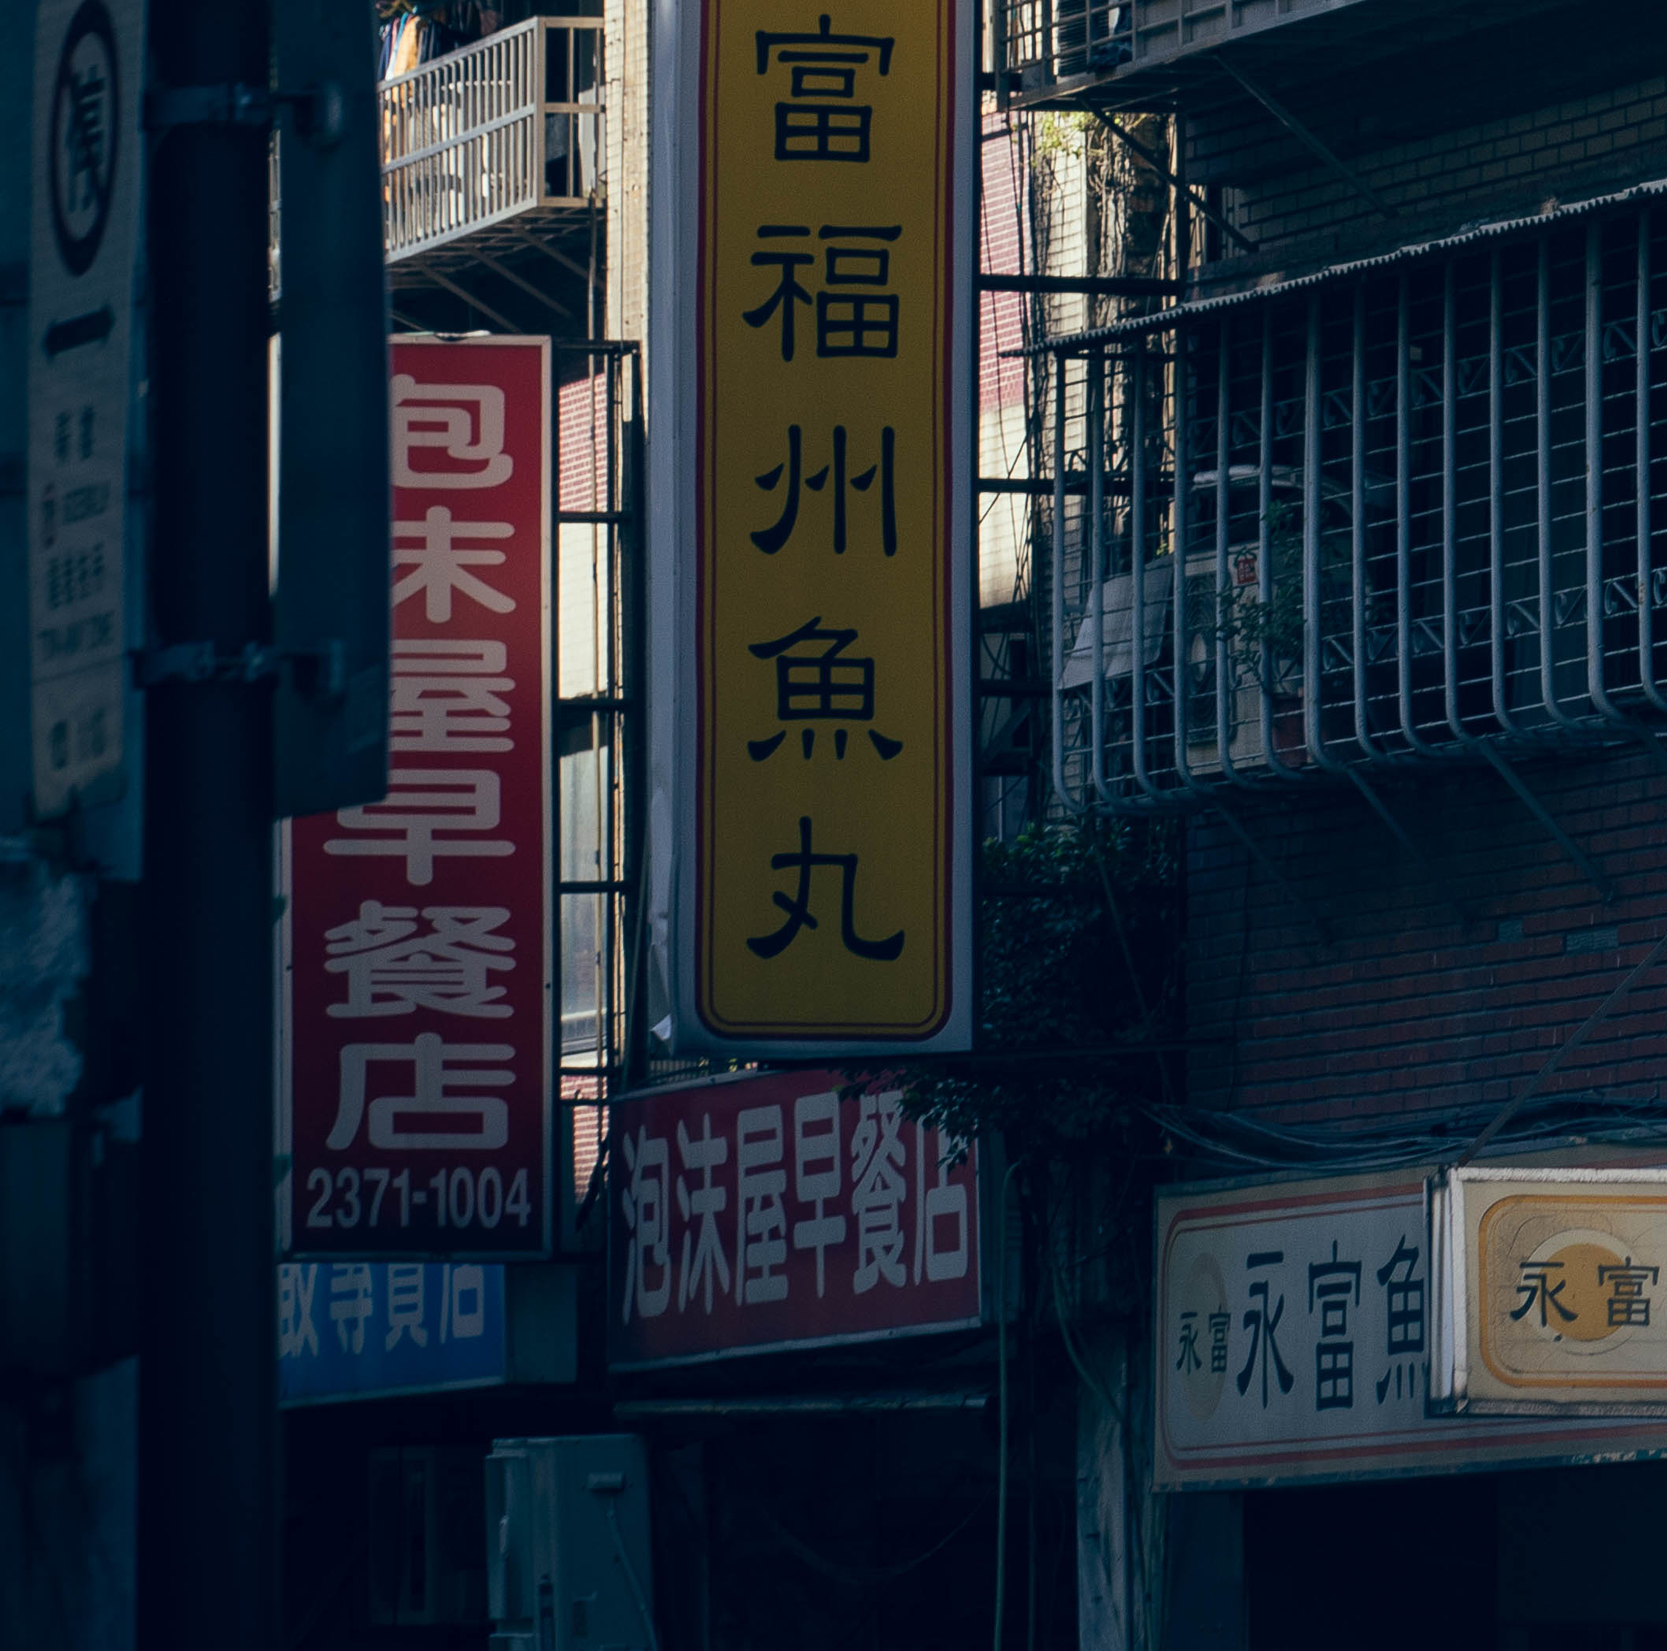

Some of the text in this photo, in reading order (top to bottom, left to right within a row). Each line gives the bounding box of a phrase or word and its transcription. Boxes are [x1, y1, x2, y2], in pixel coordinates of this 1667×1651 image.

[306, 1165, 532, 1229] 2371-1004
[621, 1089, 969, 1326] 泡沫屋早餐店
[1175, 1303, 1231, 1375] 永富
